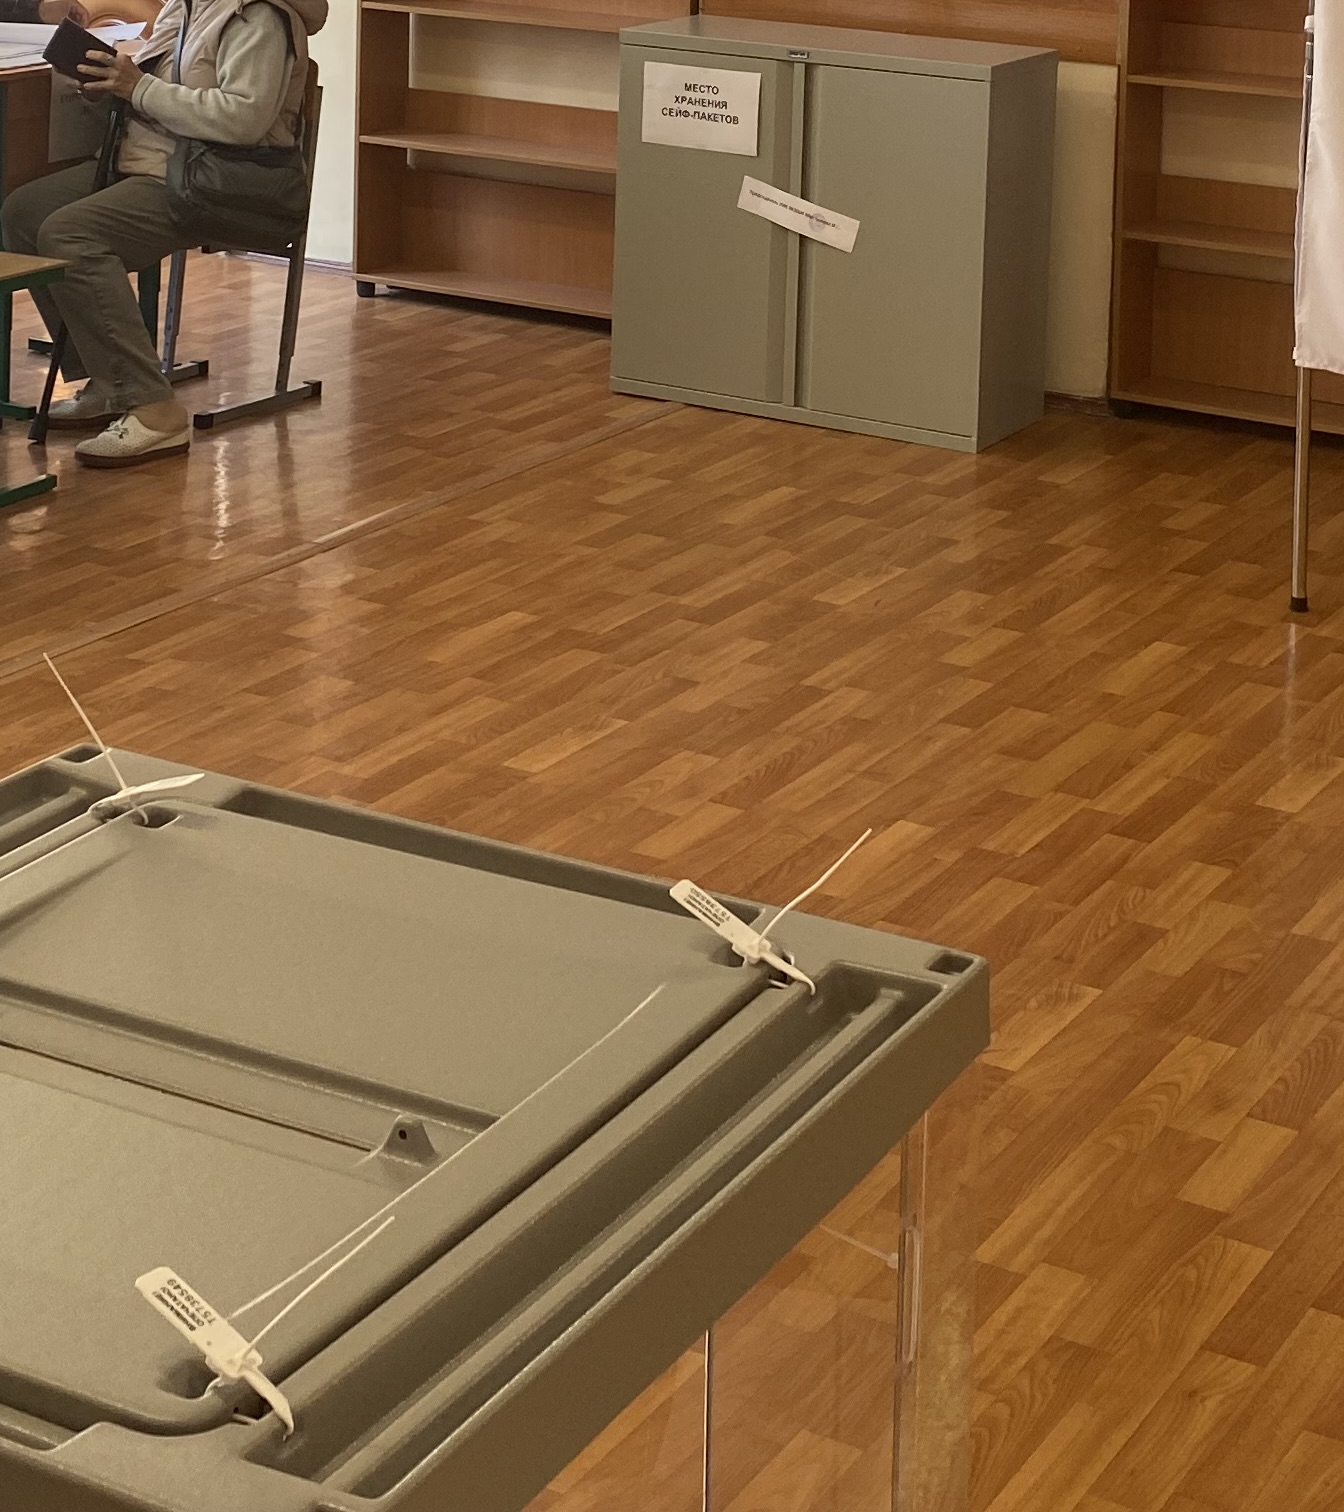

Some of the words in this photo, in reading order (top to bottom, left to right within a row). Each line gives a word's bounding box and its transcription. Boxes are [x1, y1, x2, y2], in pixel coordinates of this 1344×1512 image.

[684, 82, 719, 96] МЕСТО
[673, 95, 728, 110] ХРАНЕНИЯ
[661, 106, 739, 125] СЕЙФ-ПАКЕТОВ
